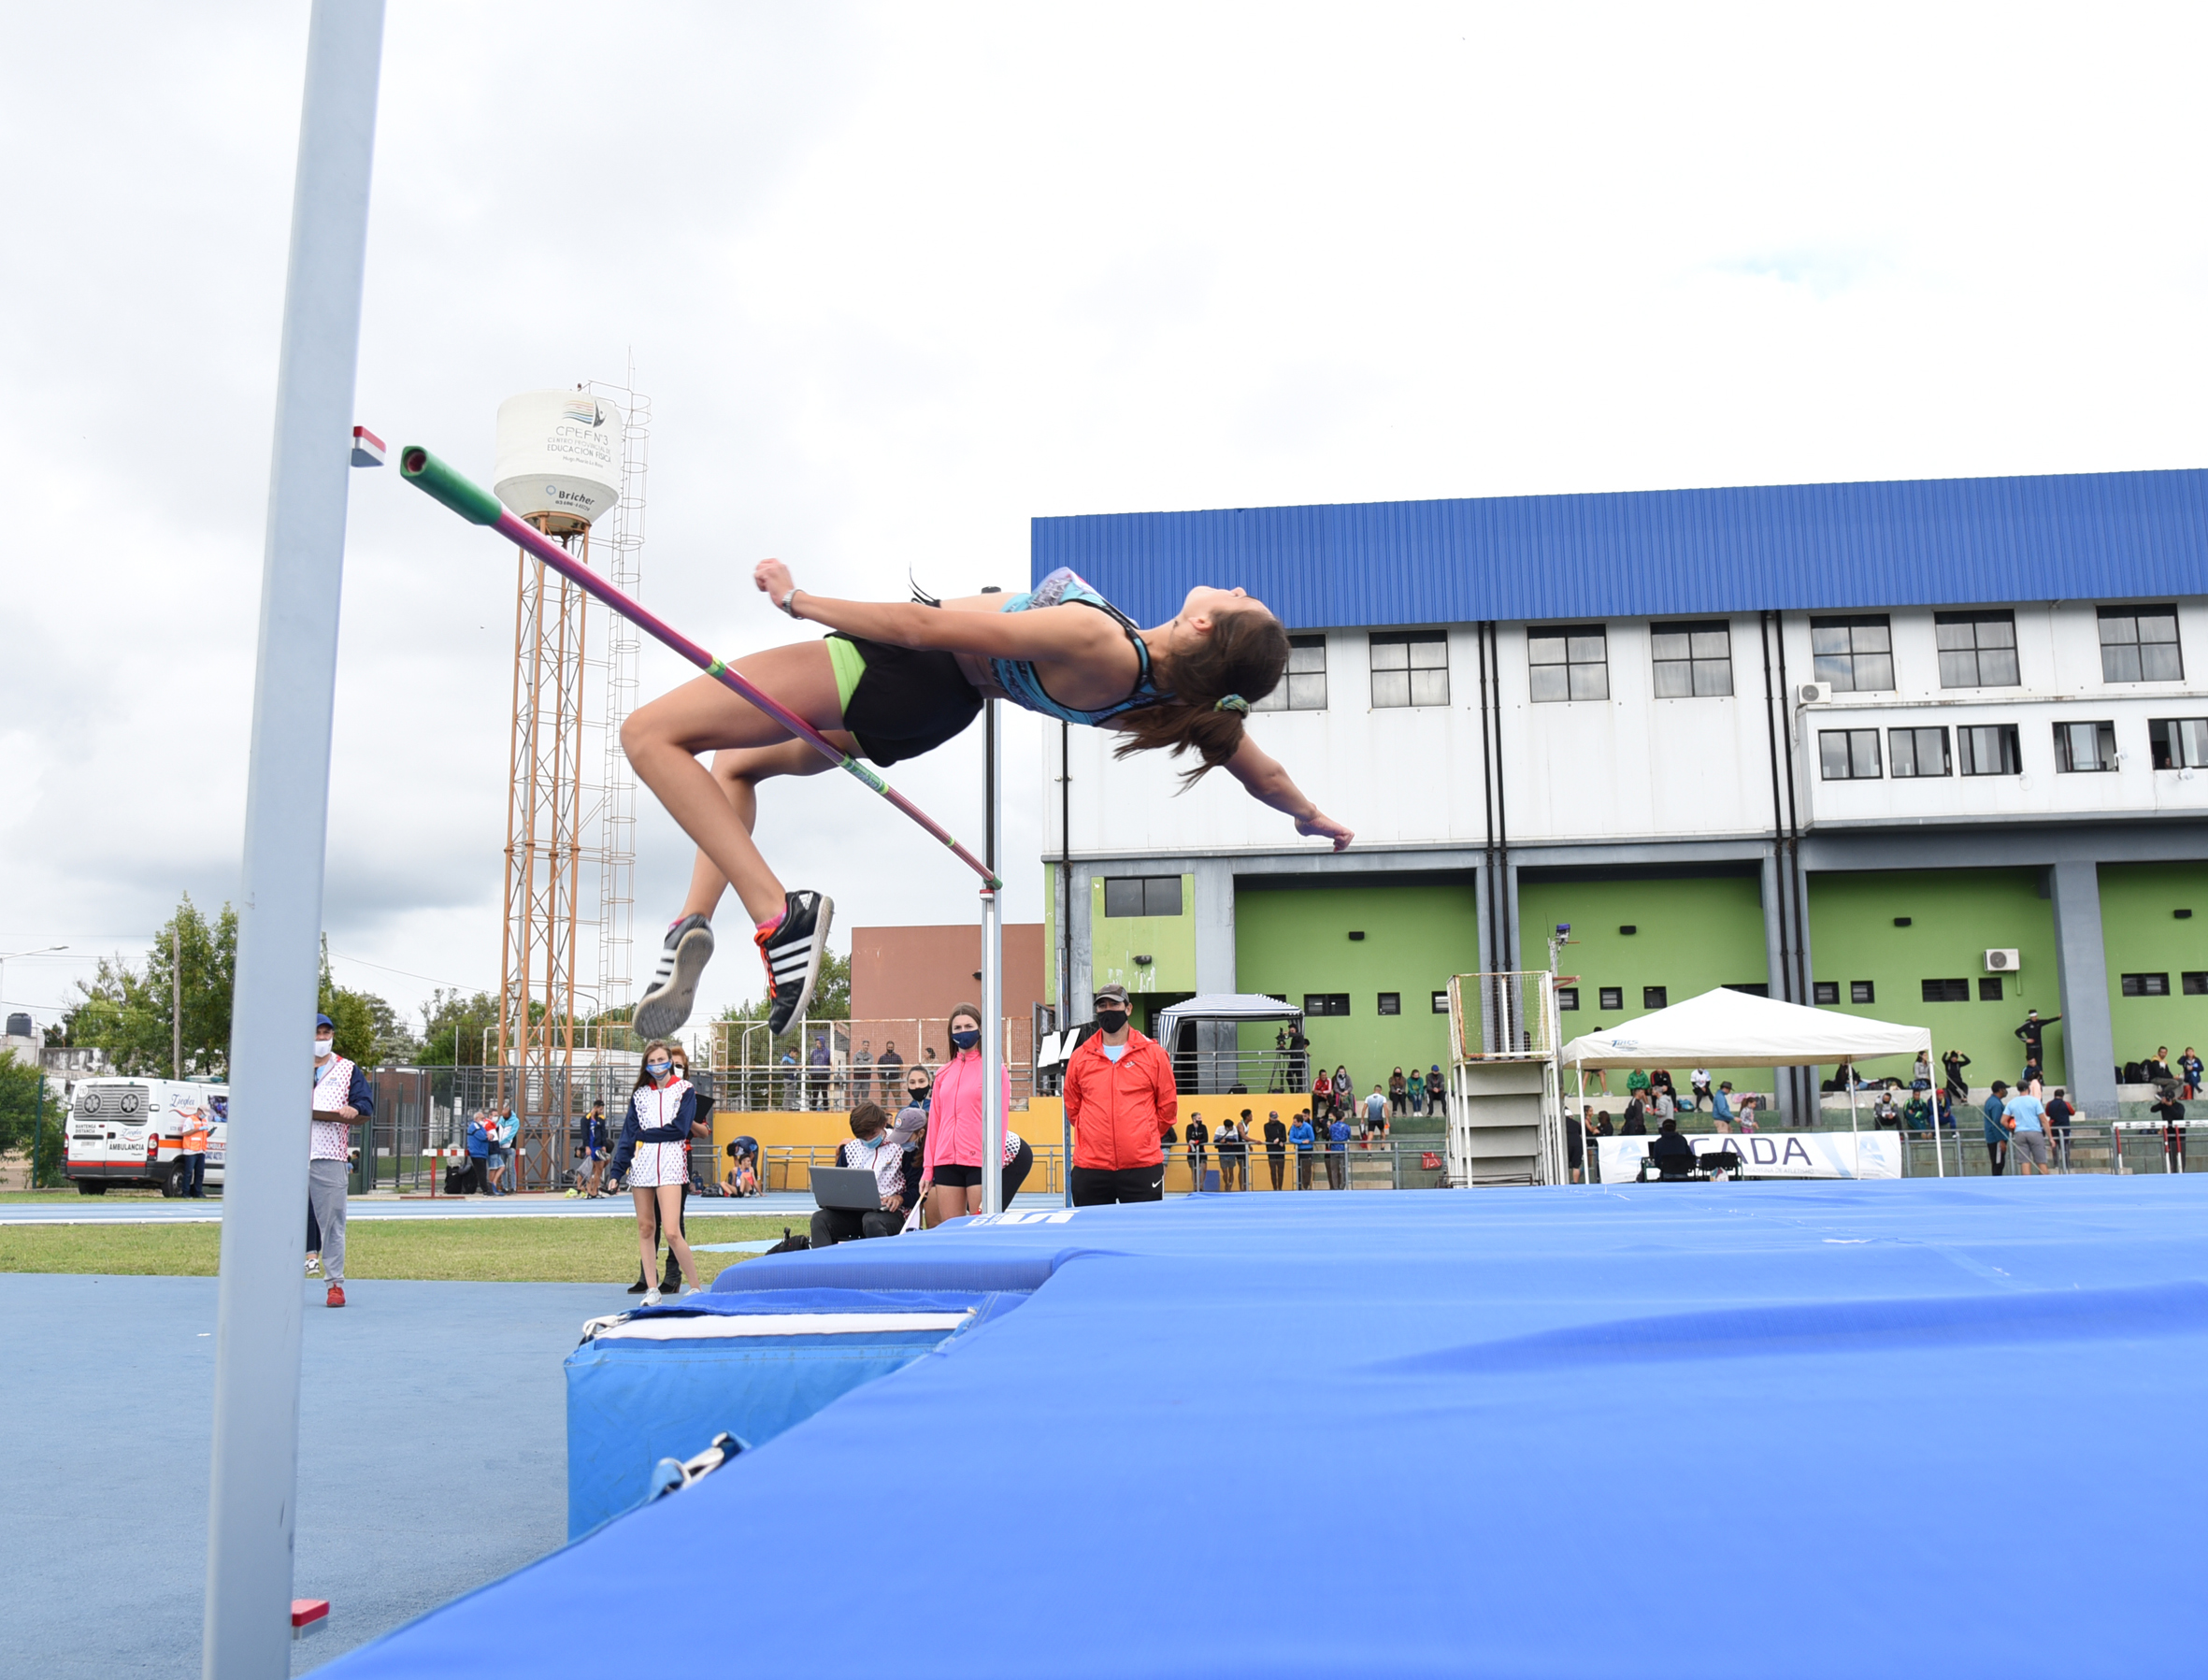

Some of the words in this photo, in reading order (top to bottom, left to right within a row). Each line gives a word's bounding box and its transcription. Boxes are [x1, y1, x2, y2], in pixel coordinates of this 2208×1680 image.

[556, 426, 593, 439] CPEF
[558, 491, 595, 506] Bricher
[109, 1142, 144, 1151] AMBULANCIA
